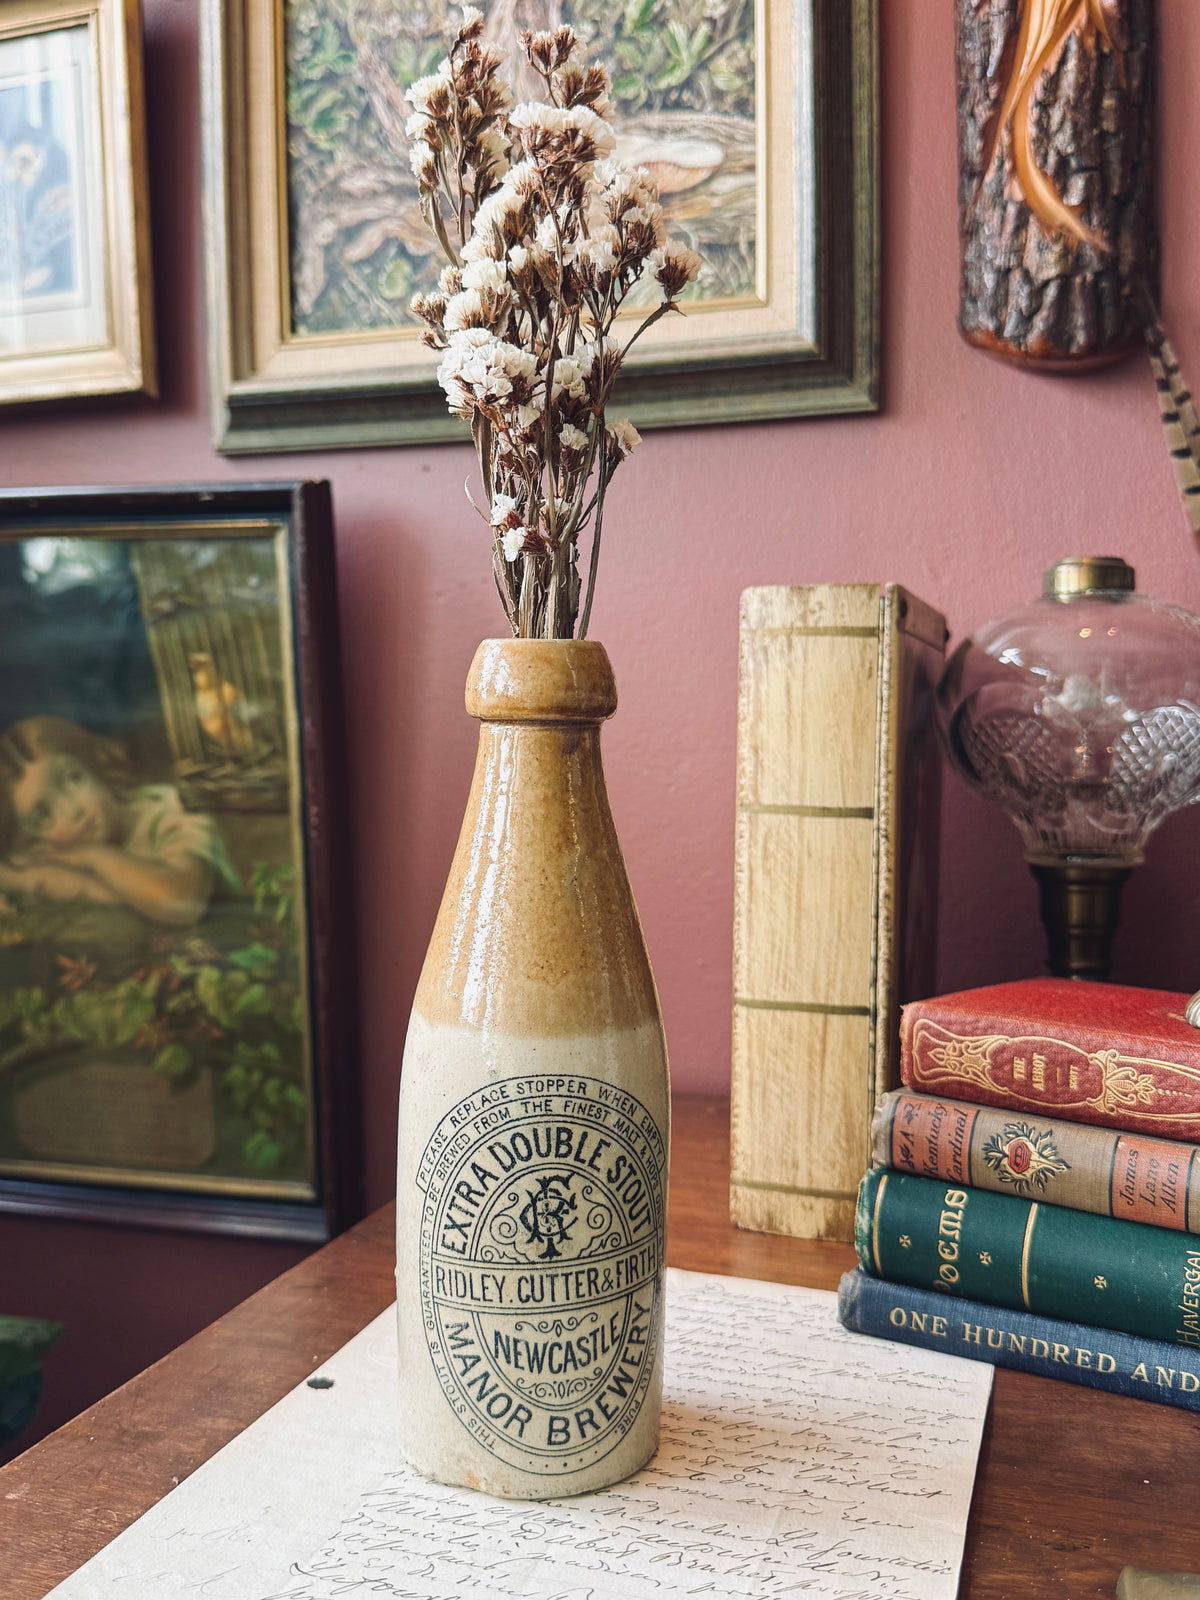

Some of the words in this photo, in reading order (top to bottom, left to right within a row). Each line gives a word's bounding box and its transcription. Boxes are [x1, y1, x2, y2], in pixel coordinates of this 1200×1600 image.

[1013, 1056, 1026, 1079] THE
[1032, 1052, 1047, 1091] ABBOT
[473, 1107, 511, 1136] FROM
[521, 1100, 552, 1113] THE
[564, 1101, 611, 1123] FINEST
[419, 1129, 448, 1184] PLEASE
[450, 1084, 510, 1128] REPLACE
[516, 1079, 587, 1095] STOPPER
[599, 1086, 638, 1116] WHEN
[612, 1118, 641, 1146] MALT
[923, 1102, 948, 1176] Kentucky
[946, 1107, 968, 1181] Cardinal
[436, 1135, 471, 1180] BREWED
[645, 1155, 659, 1191] HOPS
[1119, 1148, 1139, 1207] James
[428, 1182, 441, 1203] BE
[440, 1162, 500, 1255] EXTRA
[487, 1126, 612, 1173] DOUBLE
[606, 1154, 651, 1235] STOUT
[1139, 1158, 1159, 1207] Lane
[1160, 1162, 1179, 1214] Allen
[423, 1206, 434, 1224] TO
[421, 1229, 436, 1330] GUARANTEED
[517, 1267, 600, 1304] CUTTER
[616, 1243, 656, 1289] FIRTH
[430, 1340, 439, 1354] IS
[493, 1311, 621, 1375] NEWCASTLE
[889, 1306, 948, 1338] ONE
[963, 1321, 1117, 1375] HUNDRED
[1130, 1361, 1200, 1393] AND
[437, 1363, 466, 1414] STOUT
[445, 1321, 533, 1438] MANOR
[547, 1301, 650, 1446] BREWERY
[467, 1417, 496, 1450] THIS
